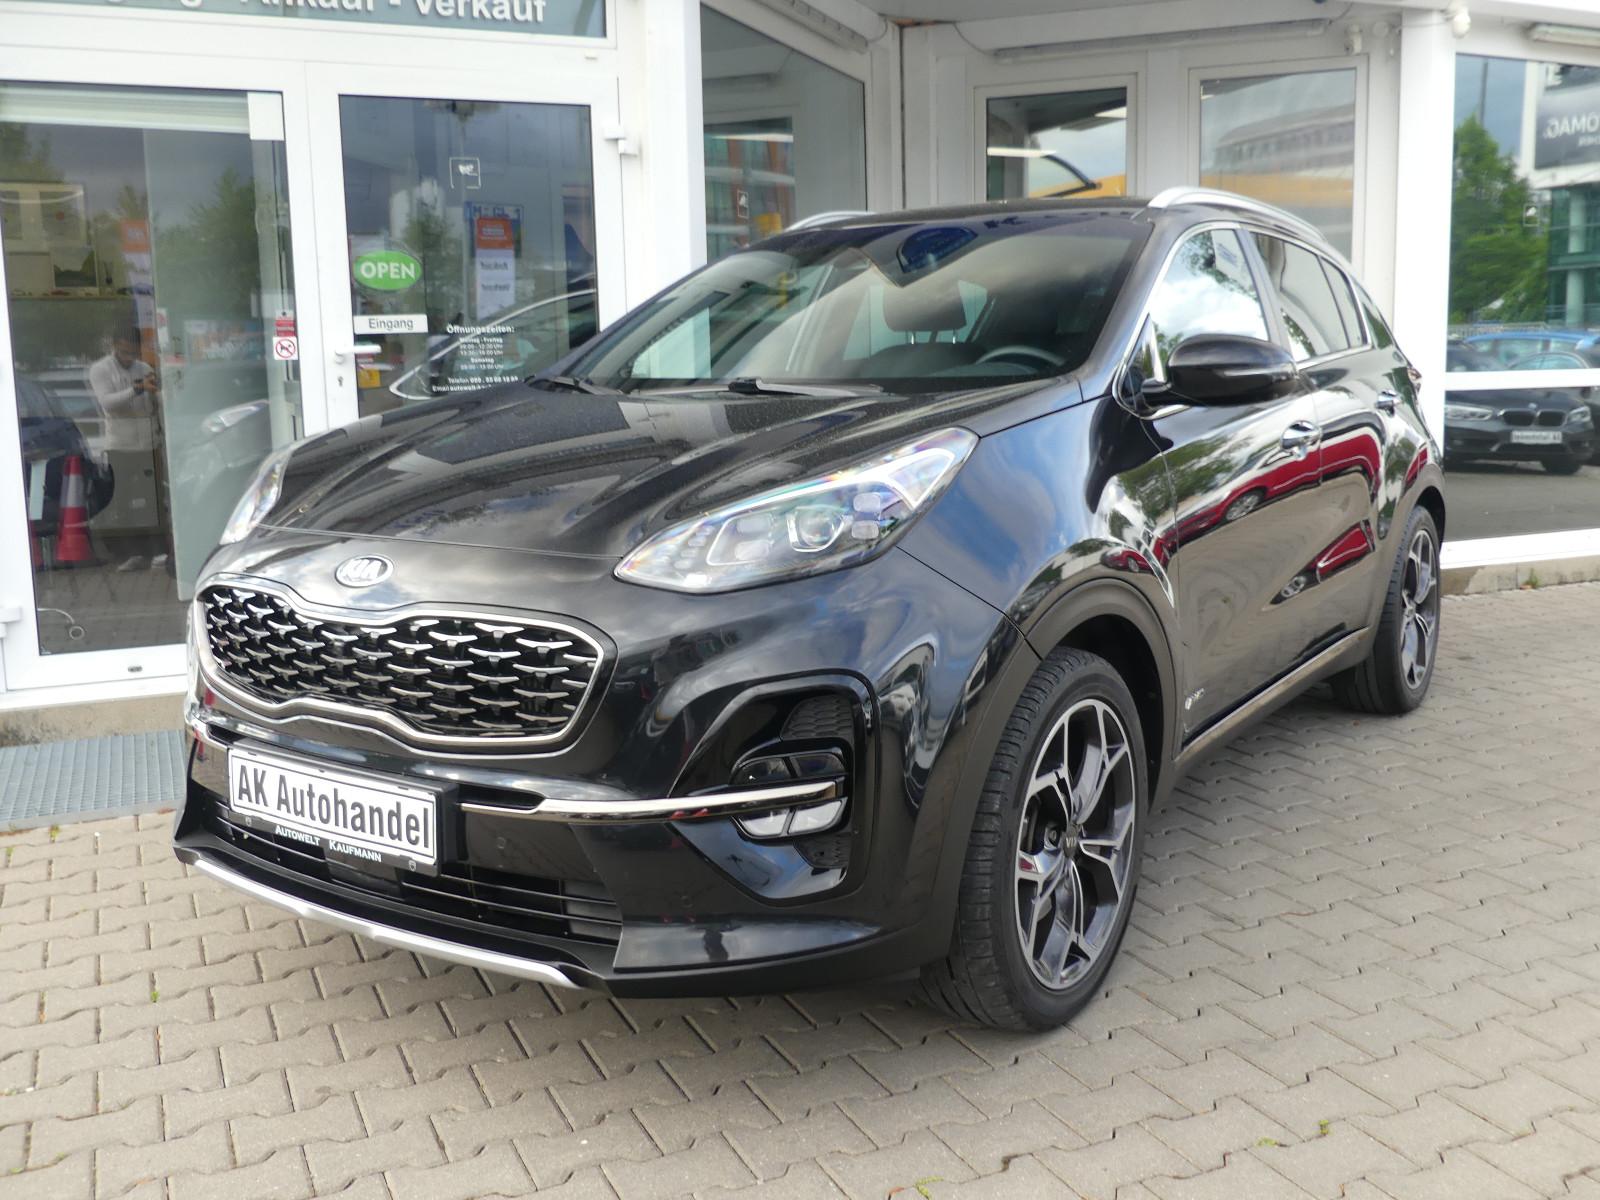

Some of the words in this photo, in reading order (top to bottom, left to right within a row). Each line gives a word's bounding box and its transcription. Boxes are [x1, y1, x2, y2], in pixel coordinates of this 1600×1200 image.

[417, 0, 548, 22] Verkauf
[360, 261, 416, 280] OPEN
[368, 318, 414, 331] Eingang
[237, 764, 269, 807] AK
[276, 774, 430, 849] Autohandel
[275, 825, 320, 846] AUTOWELT
[328, 840, 382, 862] KAUFMANN
